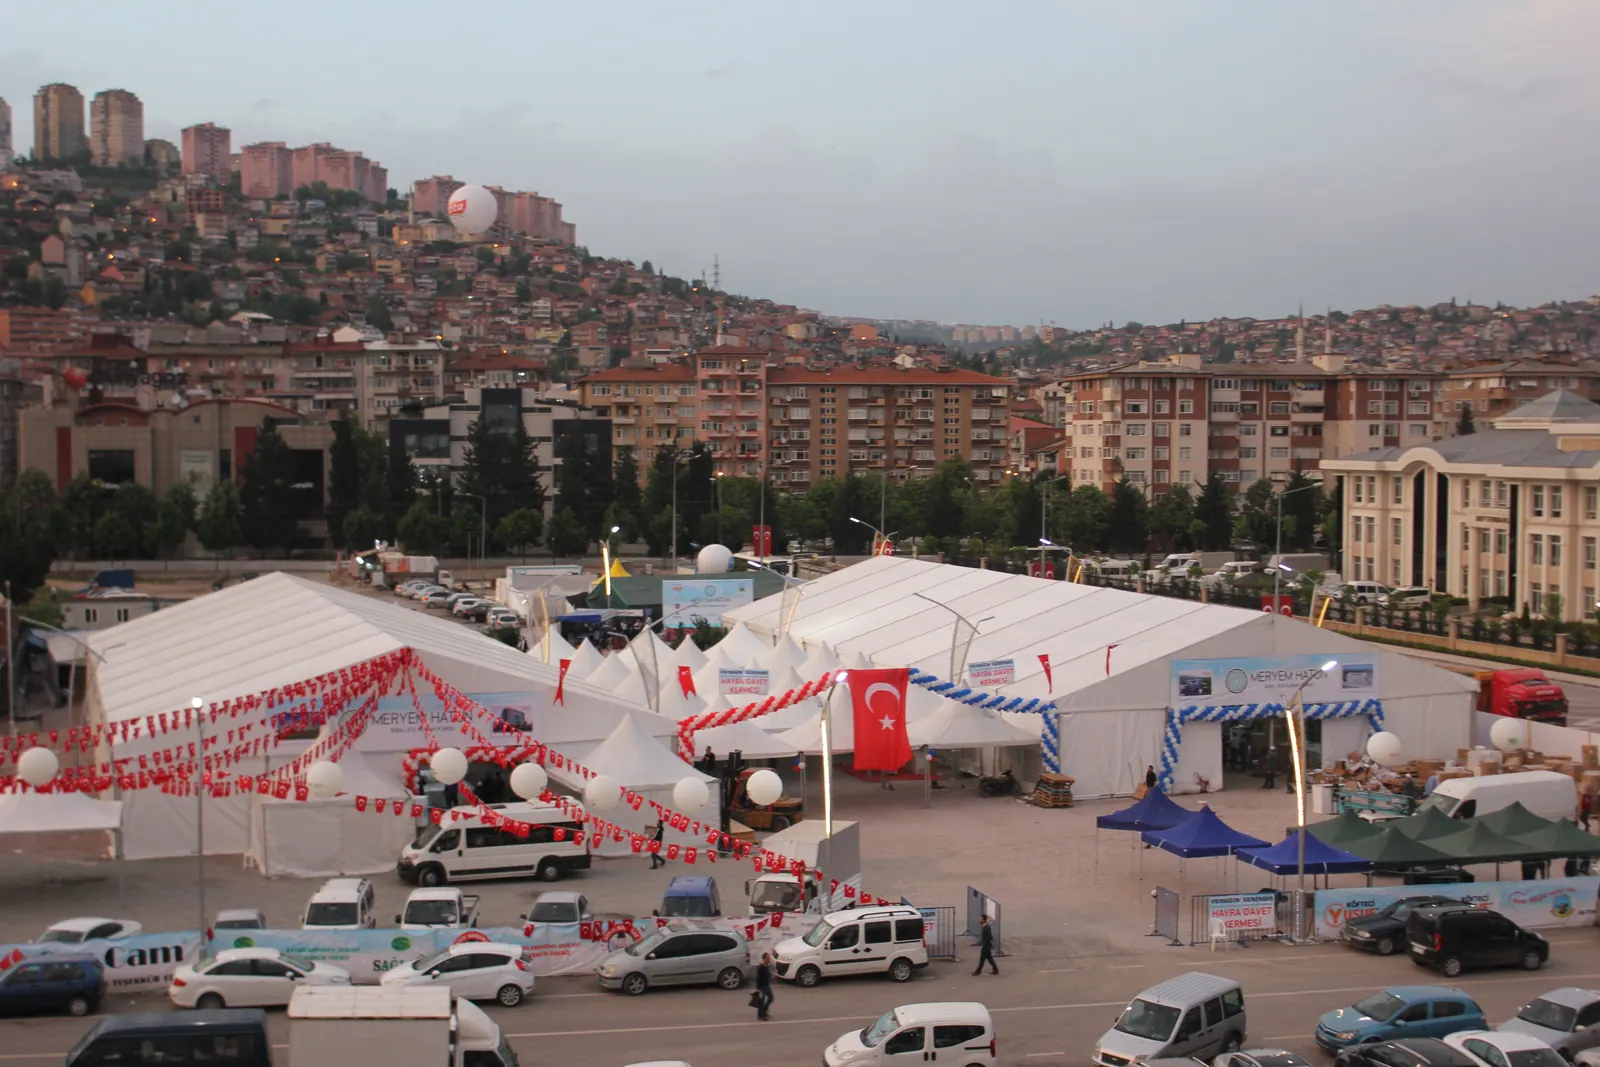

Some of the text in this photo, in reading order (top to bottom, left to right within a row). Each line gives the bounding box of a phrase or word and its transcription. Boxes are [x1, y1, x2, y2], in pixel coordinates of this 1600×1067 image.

[1250, 669, 1292, 682] MERYEM
[431, 710, 473, 723] HATN
[1212, 907, 1272, 917] HAYRA DAVET
[104, 945, 184, 969] Cam
